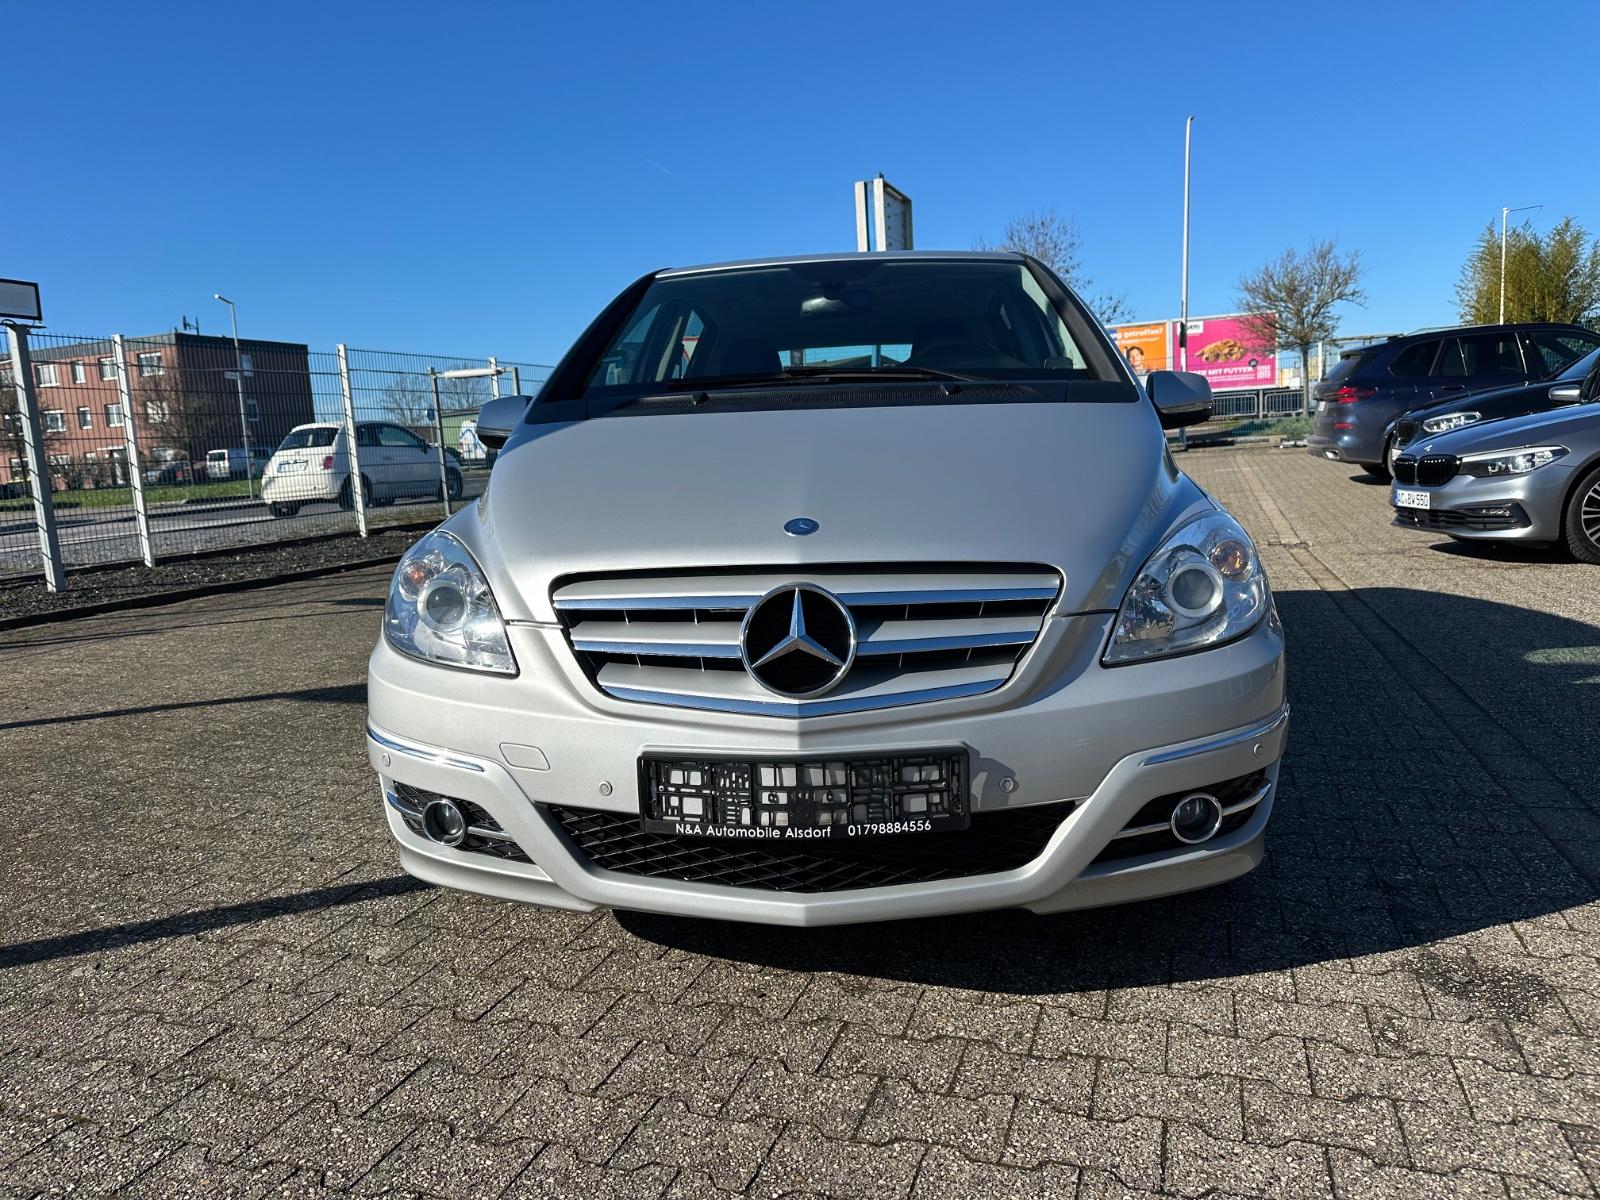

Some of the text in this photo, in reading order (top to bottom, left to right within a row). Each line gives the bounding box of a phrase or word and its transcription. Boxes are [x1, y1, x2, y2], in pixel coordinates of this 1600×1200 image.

[675, 820, 932, 838] N&A Automobile Alsdorf 01798884556
